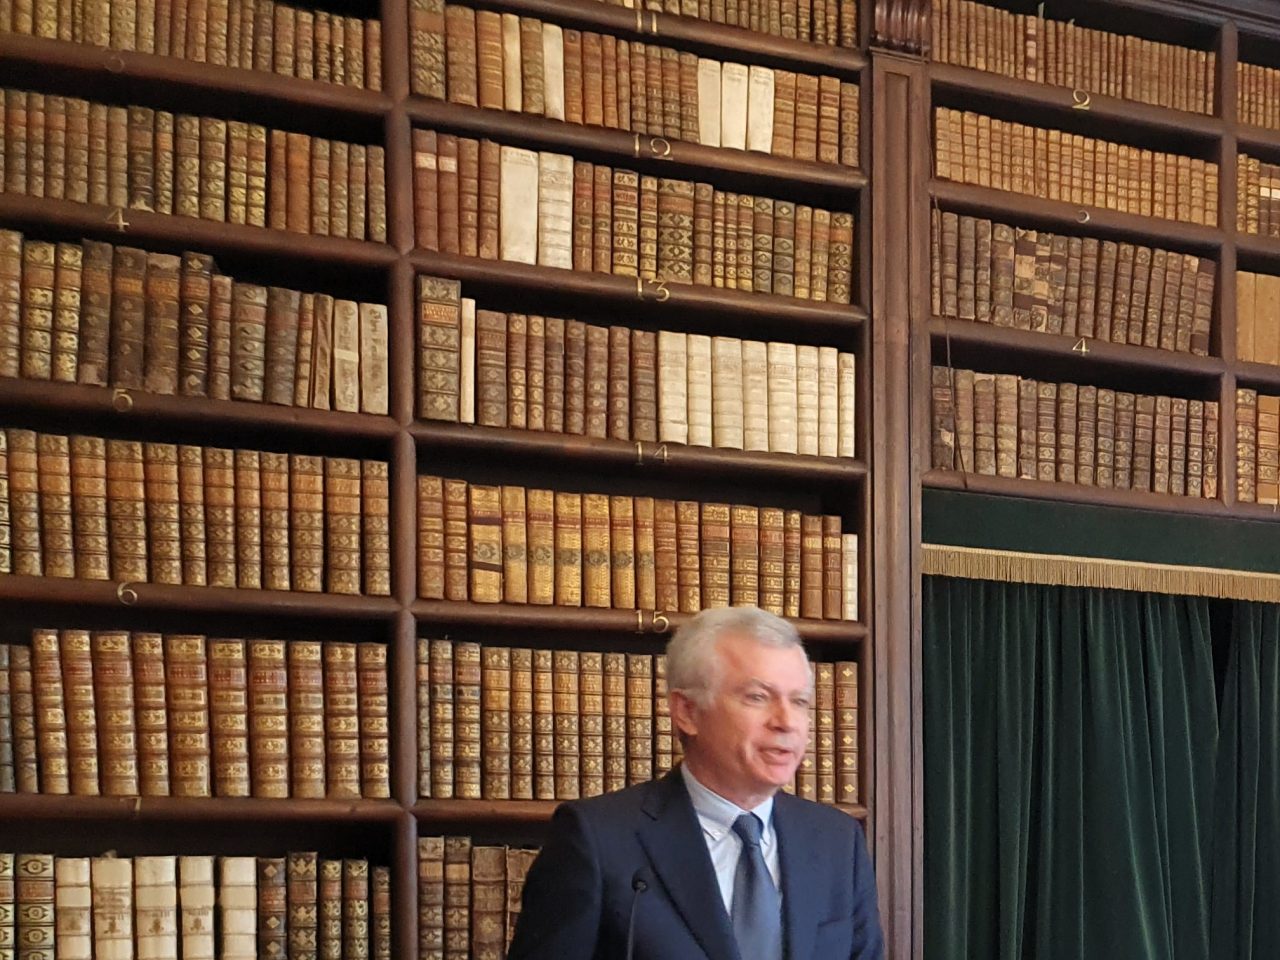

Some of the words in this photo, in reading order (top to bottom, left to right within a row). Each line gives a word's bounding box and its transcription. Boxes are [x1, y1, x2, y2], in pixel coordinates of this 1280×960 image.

[1072, 89, 1091, 110] 2
[633, 132, 672, 161] 12
[104, 207, 130, 232] 4
[635, 275, 670, 302] 13
[1072, 337, 1089, 357] 4
[112, 388, 134, 413] 5
[633, 441, 669, 466] 14
[116, 582, 138, 607] 6
[633, 609, 668, 634] 15
